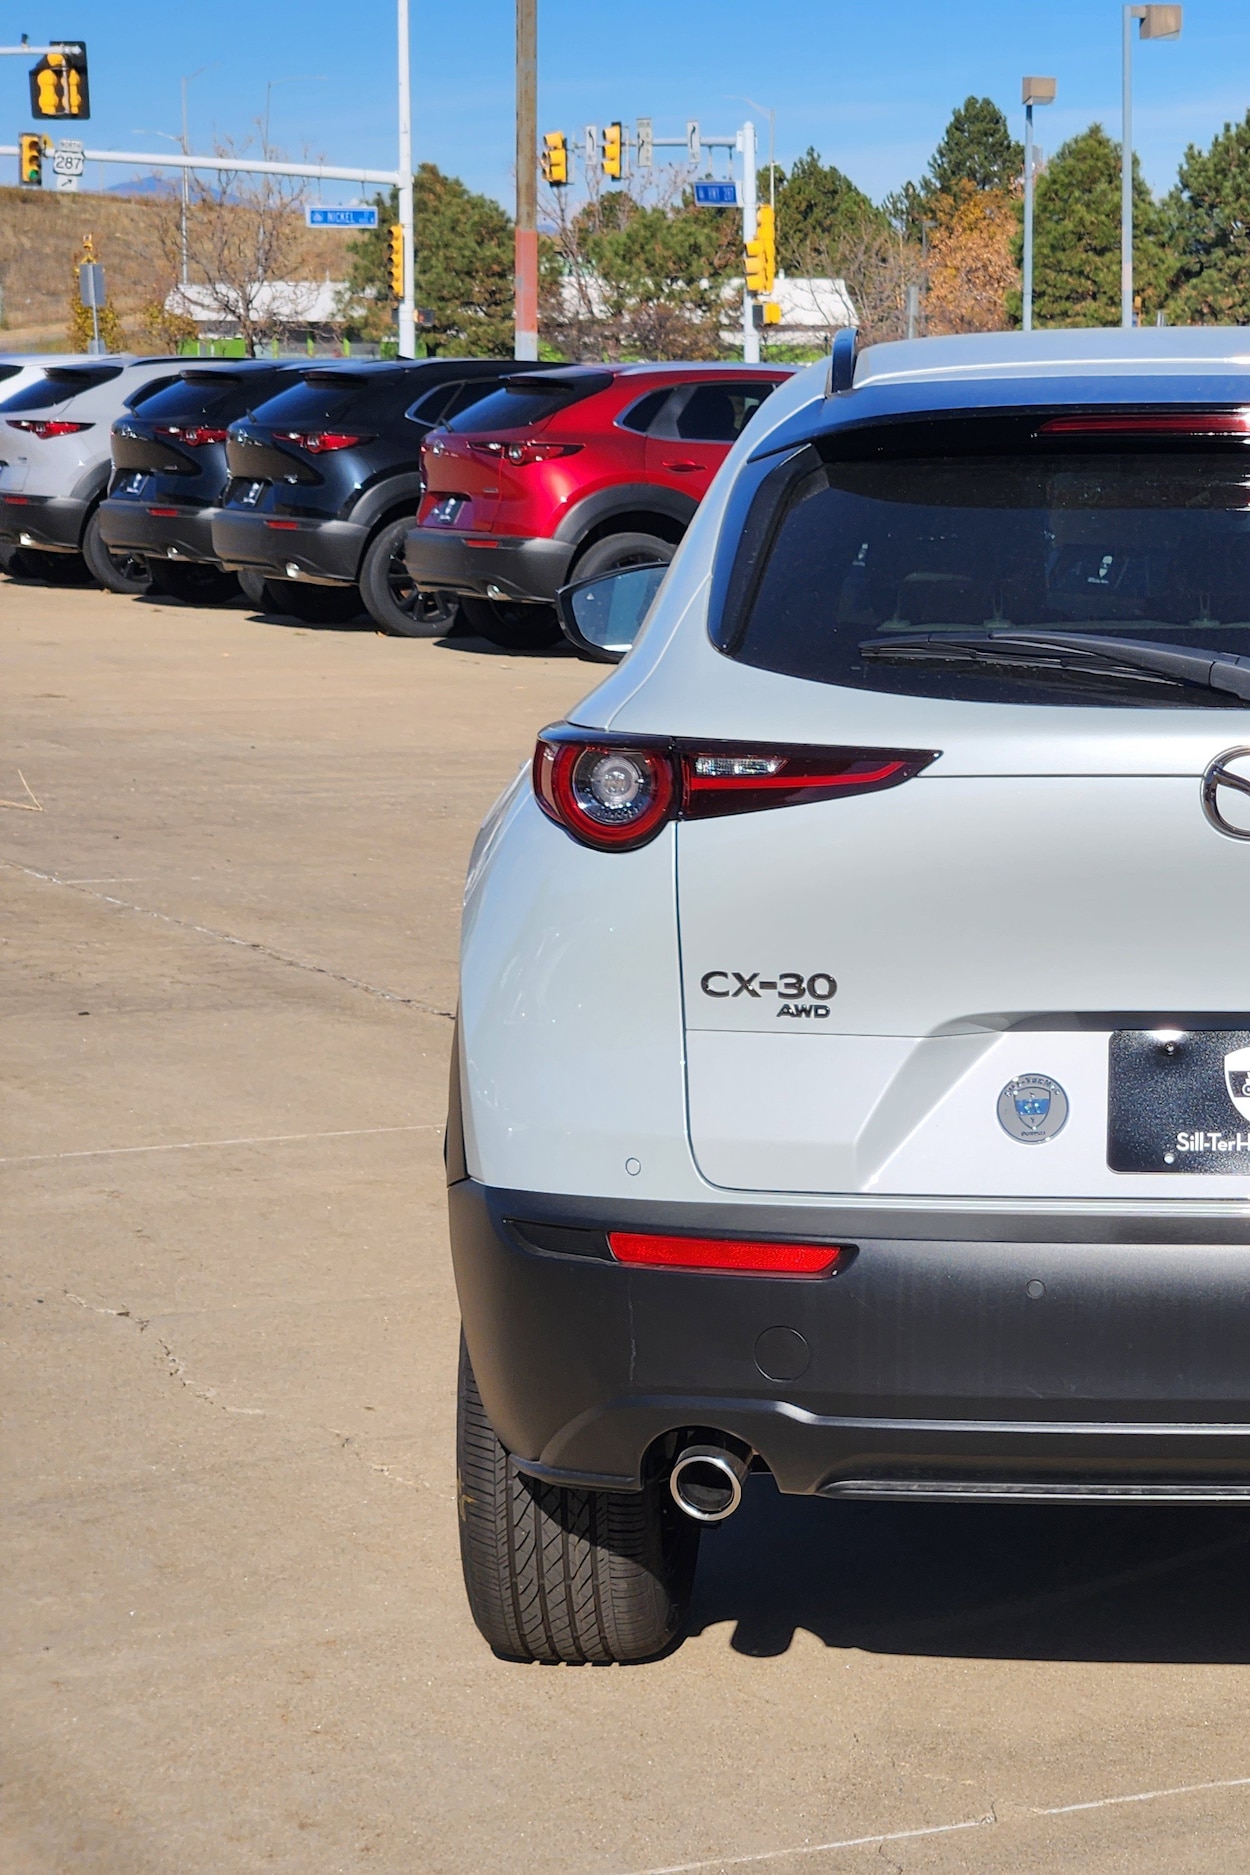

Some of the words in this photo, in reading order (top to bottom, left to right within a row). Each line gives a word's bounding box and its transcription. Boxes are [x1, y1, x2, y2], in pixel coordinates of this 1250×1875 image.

[56, 155, 81, 169] 287
[327, 211, 355, 223] NICKEL
[700, 971, 838, 1001] CX-30
[776, 1003, 831, 1019] AWD
